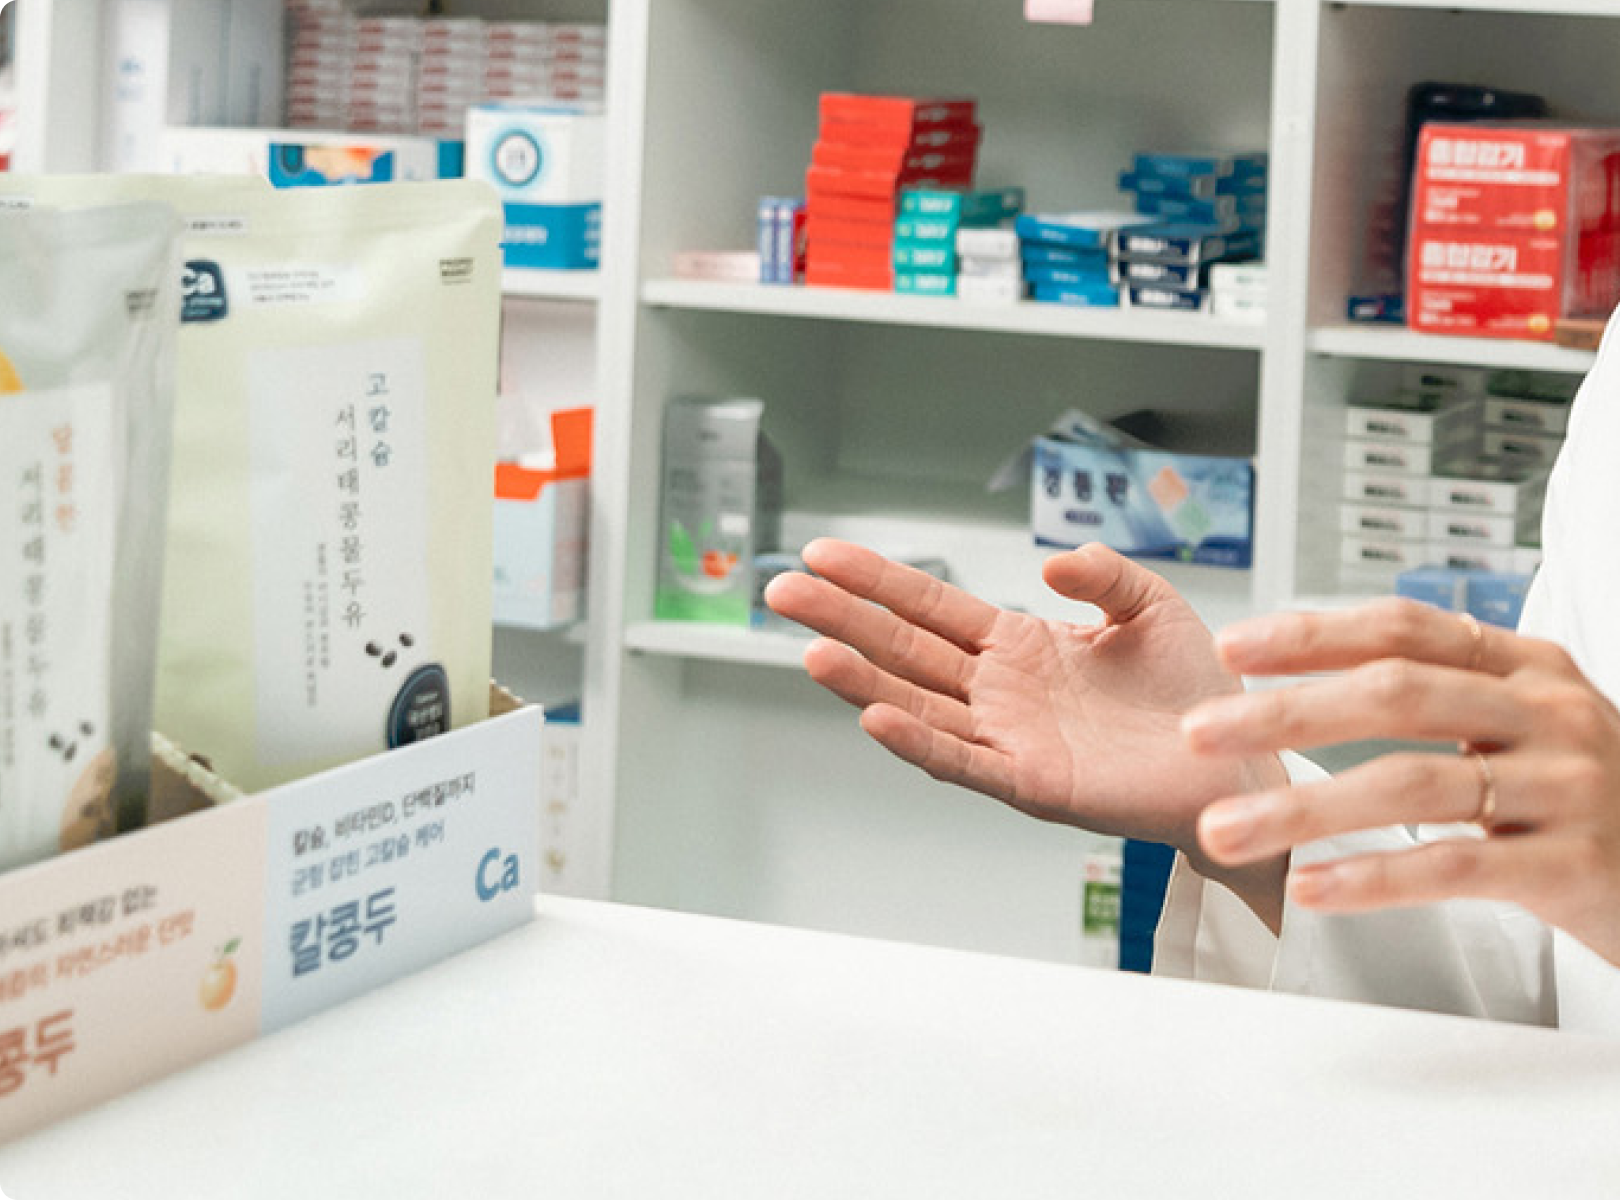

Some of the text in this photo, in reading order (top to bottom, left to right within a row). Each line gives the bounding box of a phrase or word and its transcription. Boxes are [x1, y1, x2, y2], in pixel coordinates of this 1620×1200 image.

[366, 372, 391, 468] 고칼슘
[334, 801, 398, 838] 비타민D,
[403, 771, 475, 819] 단백질까지
[365, 833, 409, 868] 고칼슘
[475, 847, 519, 902] Ca
[289, 886, 397, 978] 칼콩두
